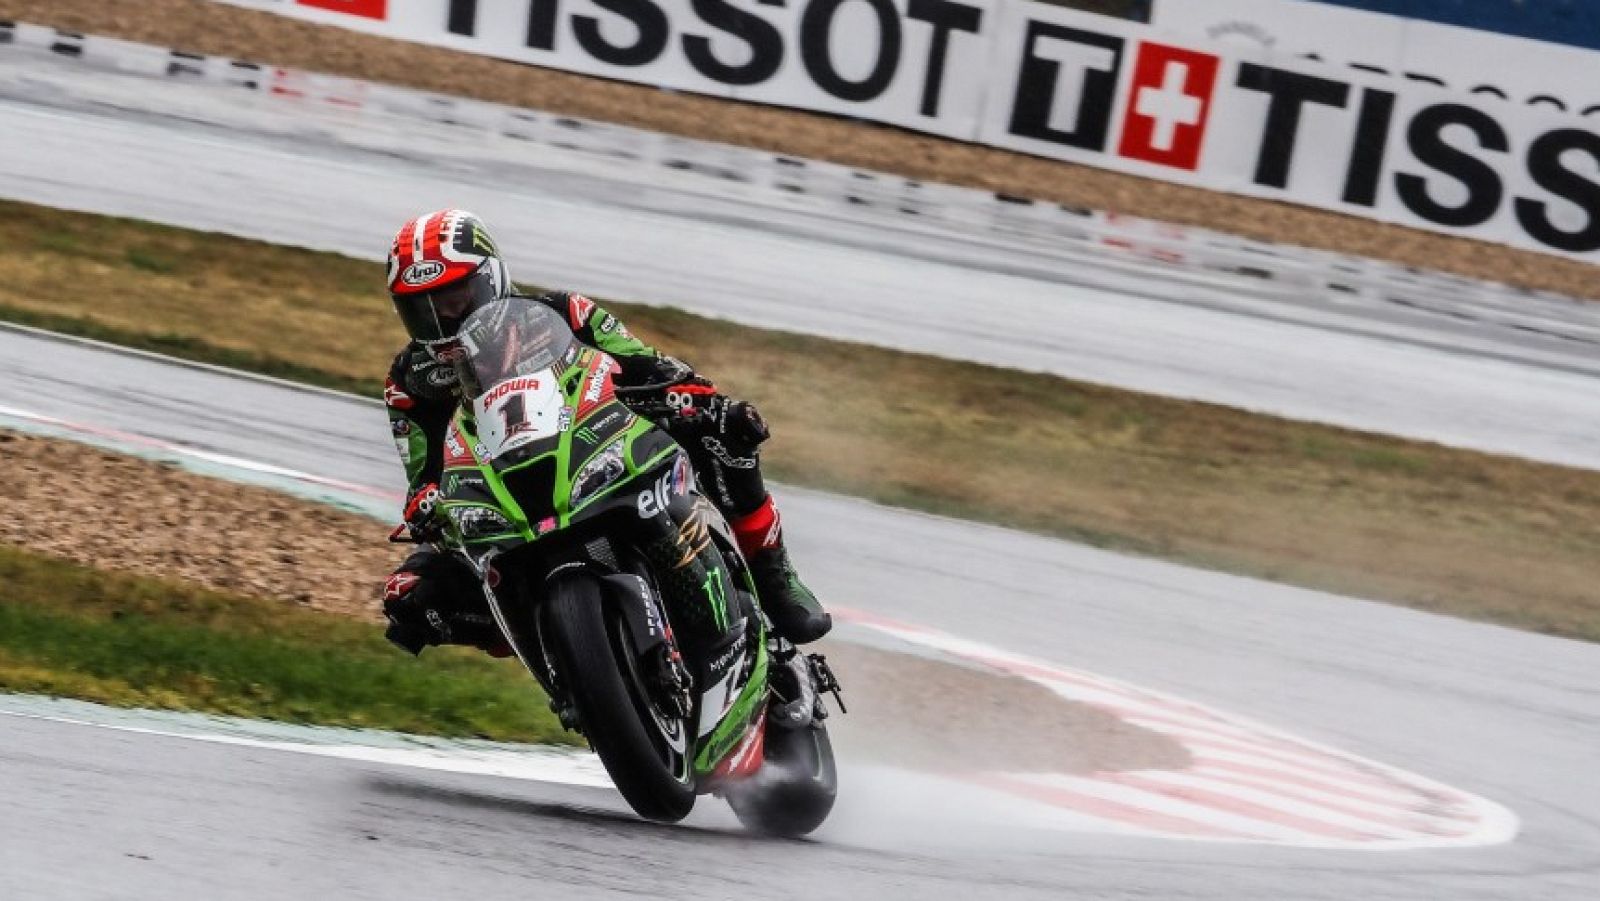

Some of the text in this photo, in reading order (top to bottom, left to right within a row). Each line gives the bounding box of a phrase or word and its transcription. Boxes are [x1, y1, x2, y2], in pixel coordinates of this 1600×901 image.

[403, 261, 443, 284] Arai
[484, 378, 540, 412] SHOWA
[498, 391, 529, 433] 1
[637, 469, 671, 519] elf
